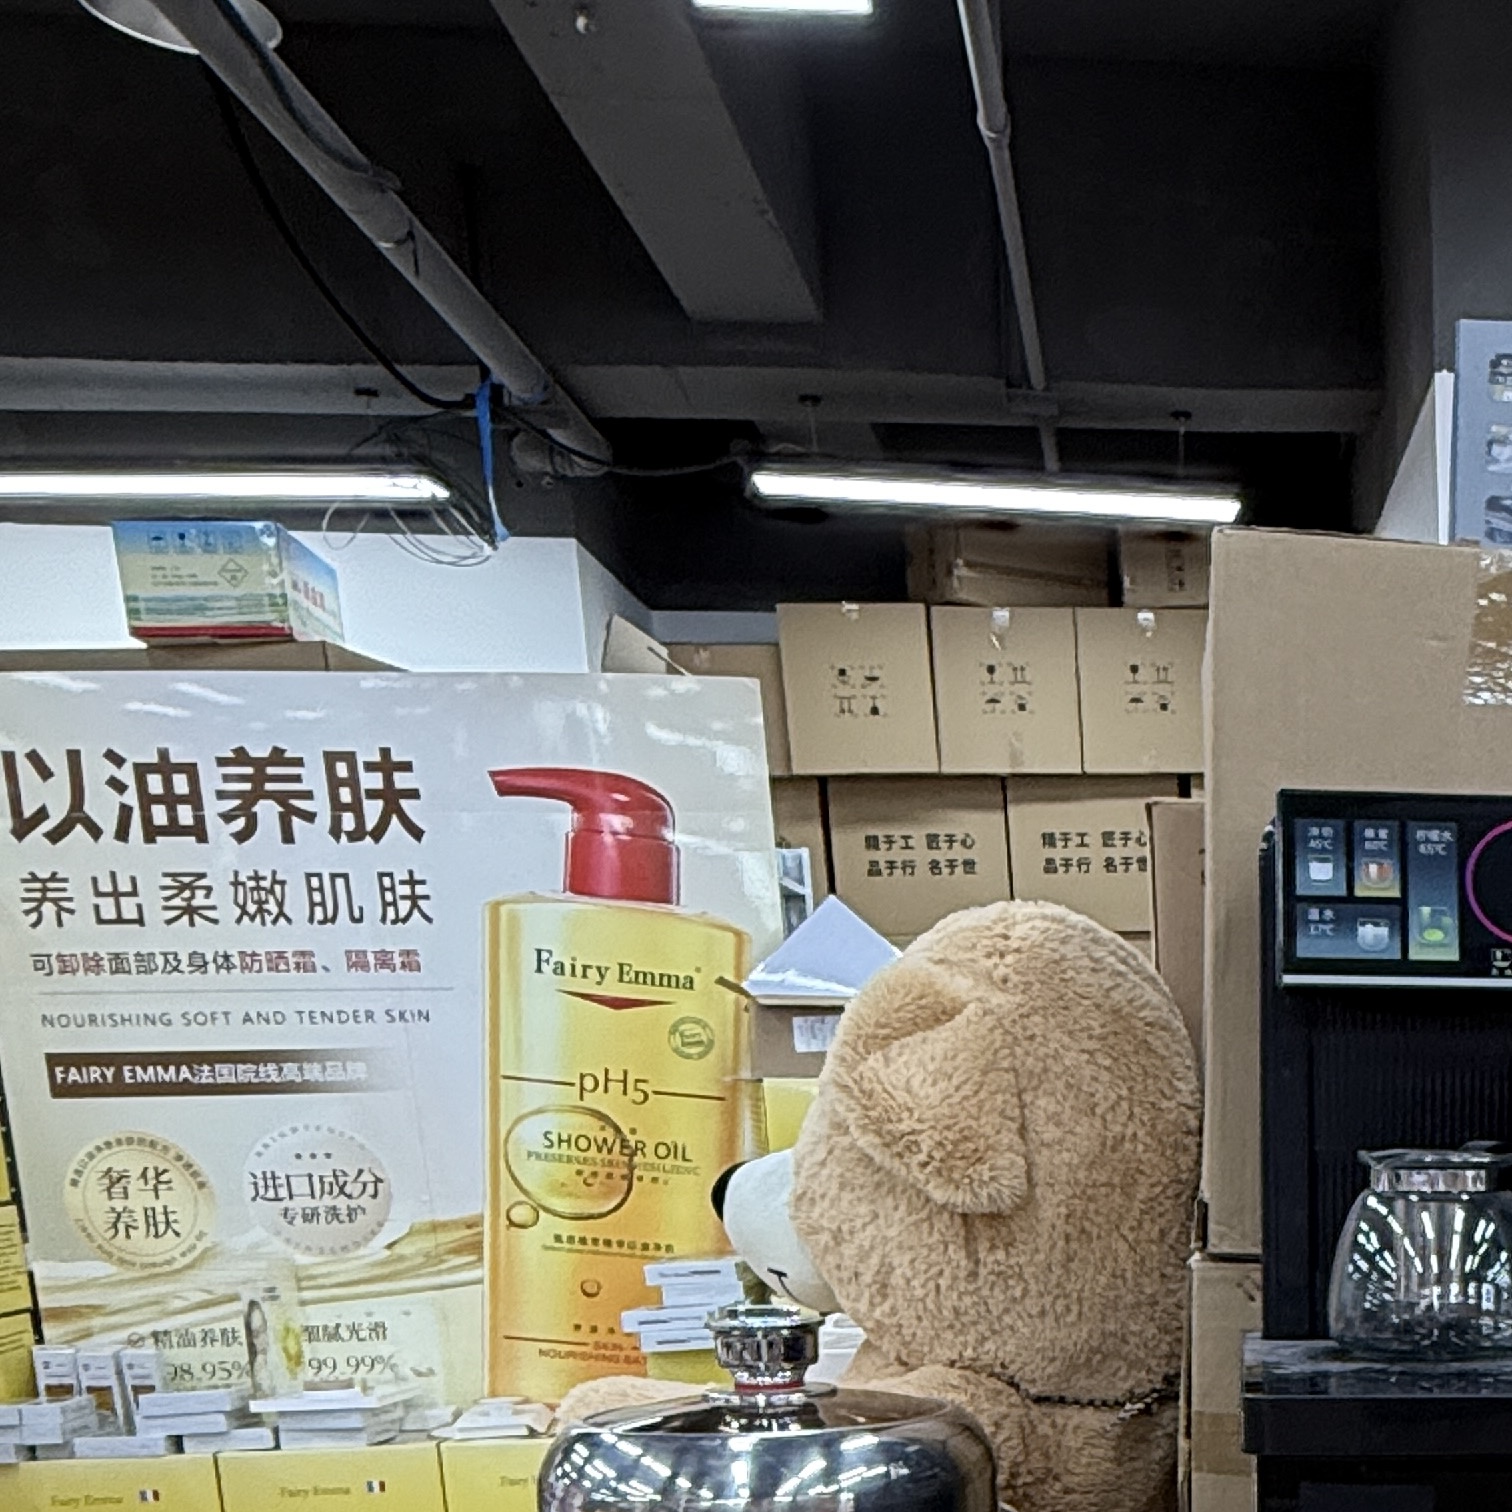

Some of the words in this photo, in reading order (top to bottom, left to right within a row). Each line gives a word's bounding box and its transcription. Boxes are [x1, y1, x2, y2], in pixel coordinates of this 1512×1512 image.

[1, 746, 426, 845] 以油养肤
[867, 859, 917, 877] 品于行
[1043, 856, 1092, 874] 品于行
[20, 869, 434, 929] 养出柔嫩肌肤
[534, 948, 610, 986] Fairy
[617, 962, 695, 991] Emma
[41, 1012, 173, 1029] NOURISHING
[181, 1010, 232, 1027] SOFT
[242, 1010, 287, 1026] AND
[296, 1009, 376, 1025] TENDER
[384, 1009, 431, 1024] SKIN
[55, 1066, 115, 1085] FAIRY
[578, 1067, 650, 1105] pH5
[543, 1130, 648, 1160] SHOWER
[654, 1140, 694, 1162] OIL
[96, 1166, 175, 1201] 奢华
[249, 1168, 385, 1202] 进口成分
[104, 1205, 182, 1240] 养肤
[280, 1204, 367, 1228] 专研洗护
